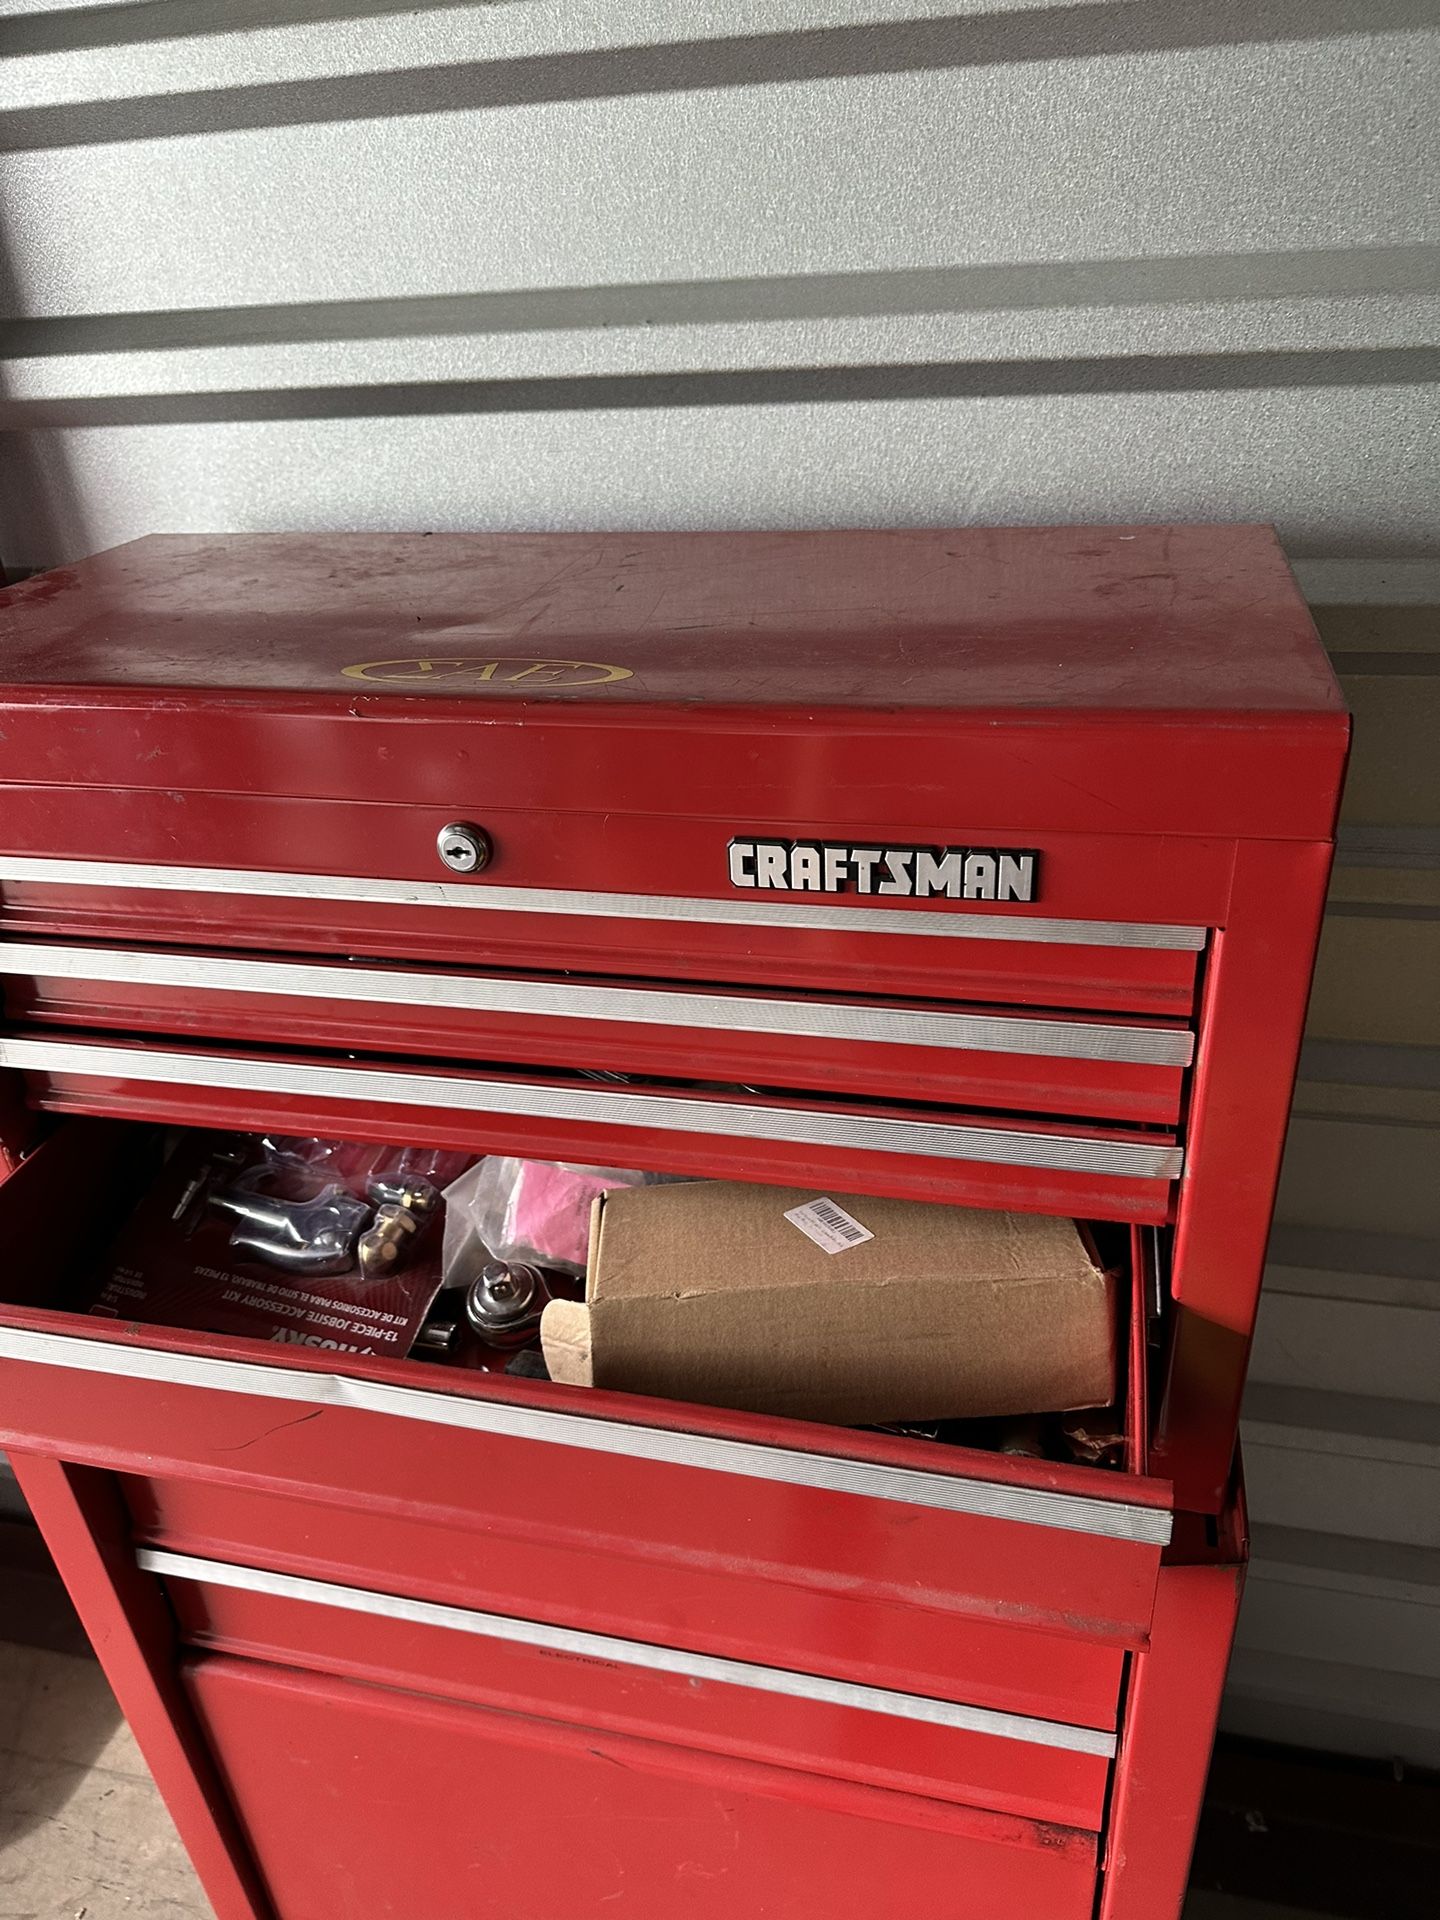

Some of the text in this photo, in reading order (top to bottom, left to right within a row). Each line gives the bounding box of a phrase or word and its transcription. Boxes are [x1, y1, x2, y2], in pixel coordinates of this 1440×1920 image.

[728, 840, 1036, 901] CRAFTSMAN
[300, 1291, 311, 1302] EL
[310, 1294, 332, 1308] PARA
[221, 1289, 399, 1342] 13-PIECE JOBSITE ACCESSORY KIT
[331, 1300, 382, 1320] ACCESORIOS
[380, 1312, 395, 1323] DE
[393, 1315, 409, 1326] KIT
[539, 1649, 621, 1670] ELECTRICAL
